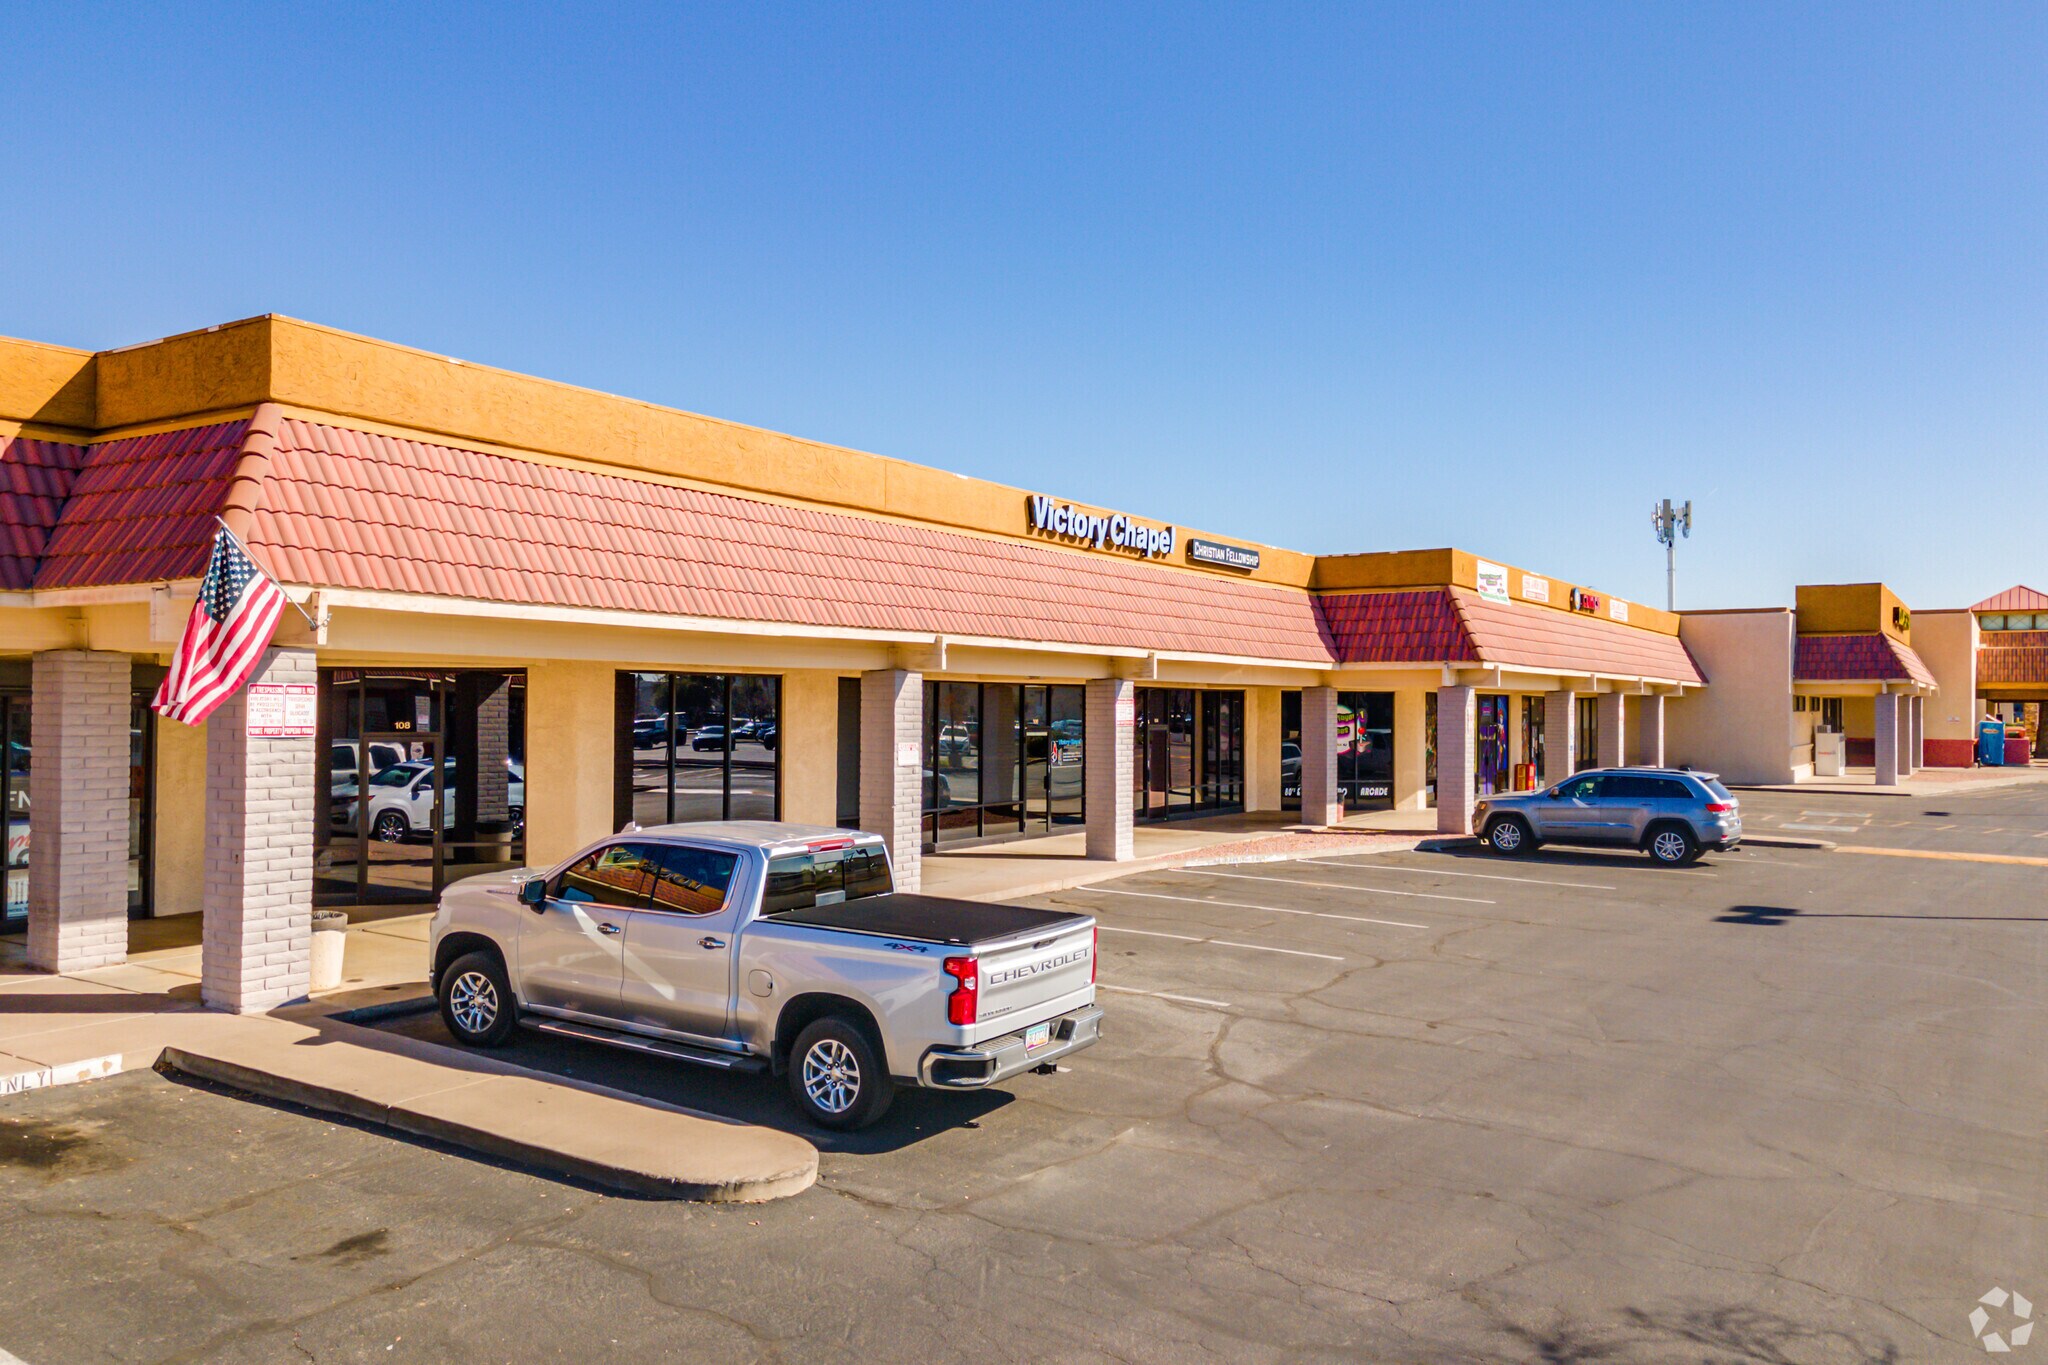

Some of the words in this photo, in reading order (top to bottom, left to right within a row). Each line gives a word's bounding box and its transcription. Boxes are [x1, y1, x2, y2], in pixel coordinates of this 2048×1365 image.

[1033, 495, 1108, 549] Victory
[1110, 513, 1177, 558] Chapel
[394, 721, 411, 730] 108
[1360, 787, 1388, 796] ARCADE
[990, 947, 1089, 985] CHEVROLET
[0, 1071, 46, 1093] NLY
